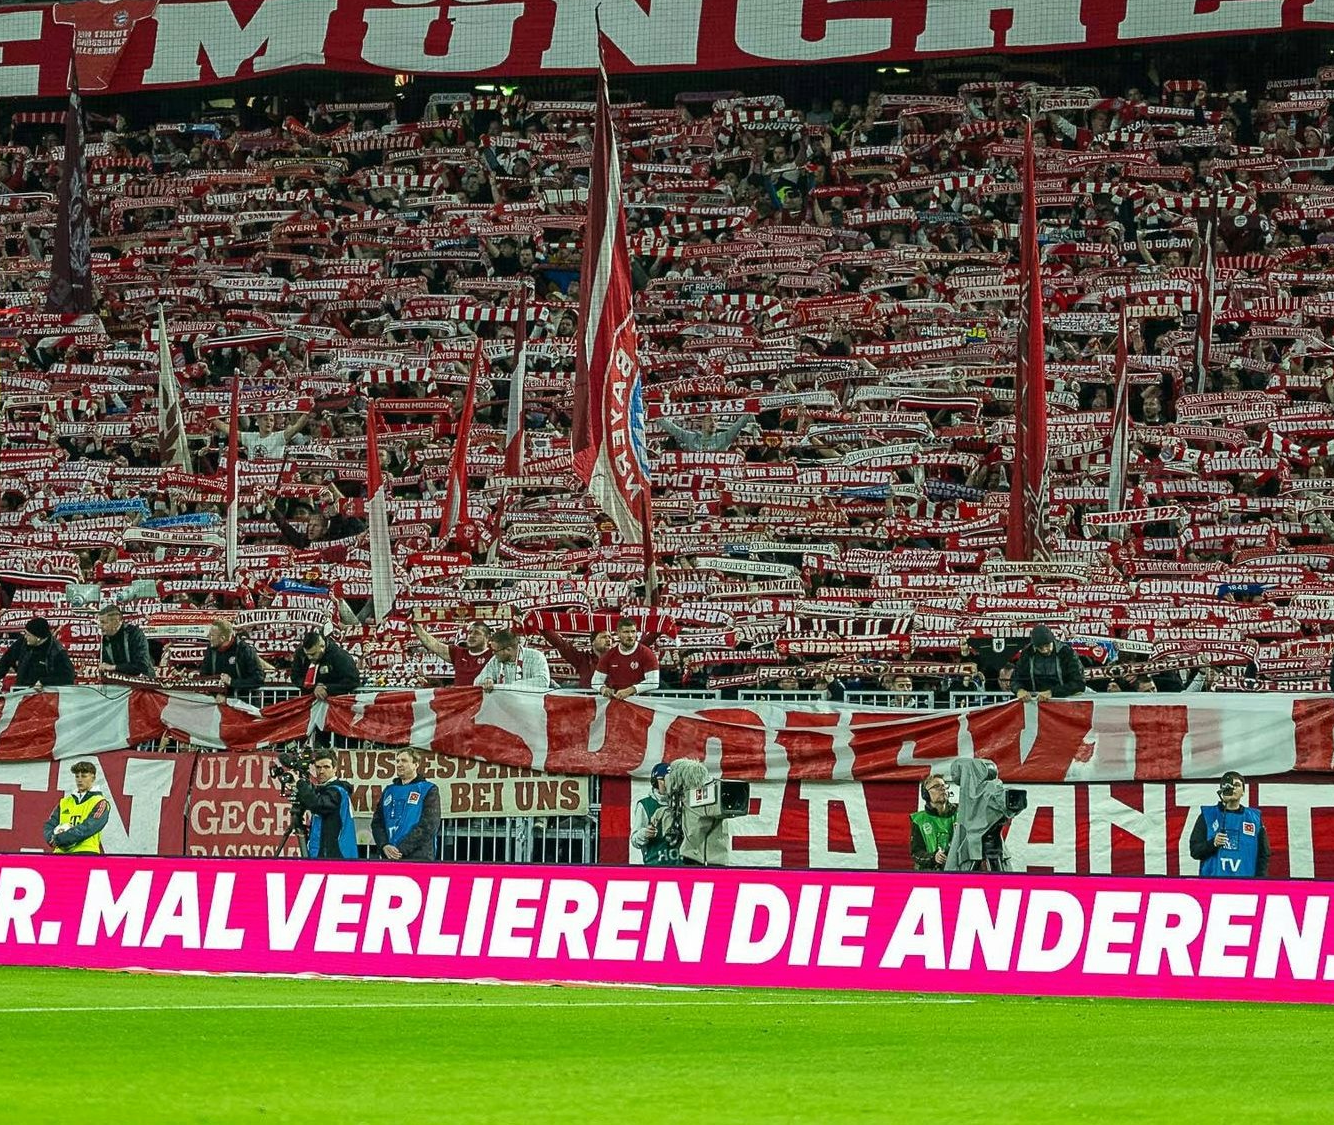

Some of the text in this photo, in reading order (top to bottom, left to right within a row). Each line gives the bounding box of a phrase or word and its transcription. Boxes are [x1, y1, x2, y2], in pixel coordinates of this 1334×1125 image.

[747, 468, 794, 477] WIR SIND
[1204, 458, 1280, 473] SÜDKURVE
[731, 493, 811, 509] SÜDKURVE
[1147, 562, 1179, 573] BAYERN
[976, 597, 1058, 610] SÜDKURVE
[789, 639, 899, 655] SÜDKURVE
[450, 780, 581, 813] BEI UNS
[1220, 856, 1241, 872] TV
[78, 870, 245, 951] MAL
[266, 872, 715, 963] VERLIEREN
[725, 882, 876, 968] DIE
